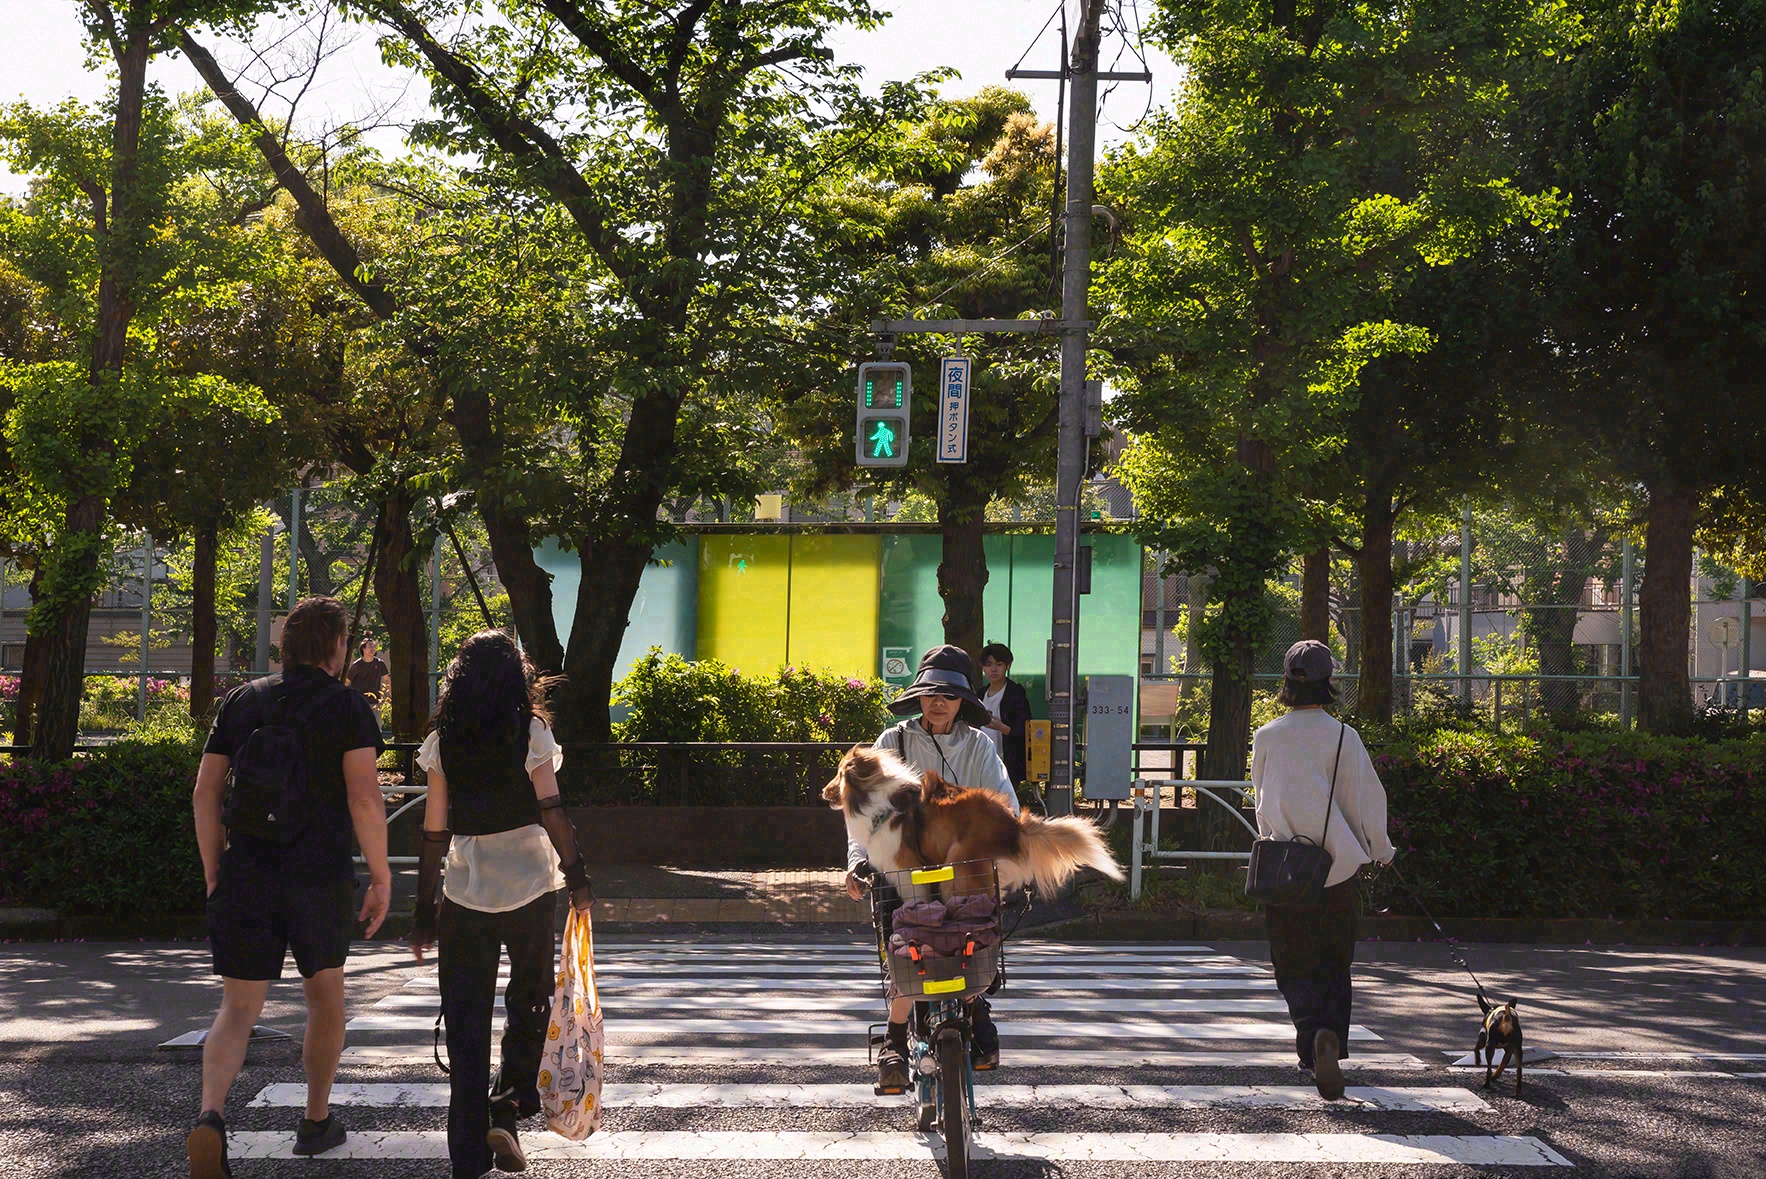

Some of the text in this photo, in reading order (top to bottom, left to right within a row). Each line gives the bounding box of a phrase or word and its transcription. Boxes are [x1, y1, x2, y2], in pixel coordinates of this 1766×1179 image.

[947, 366, 964, 454] 夜間押ボタン式
